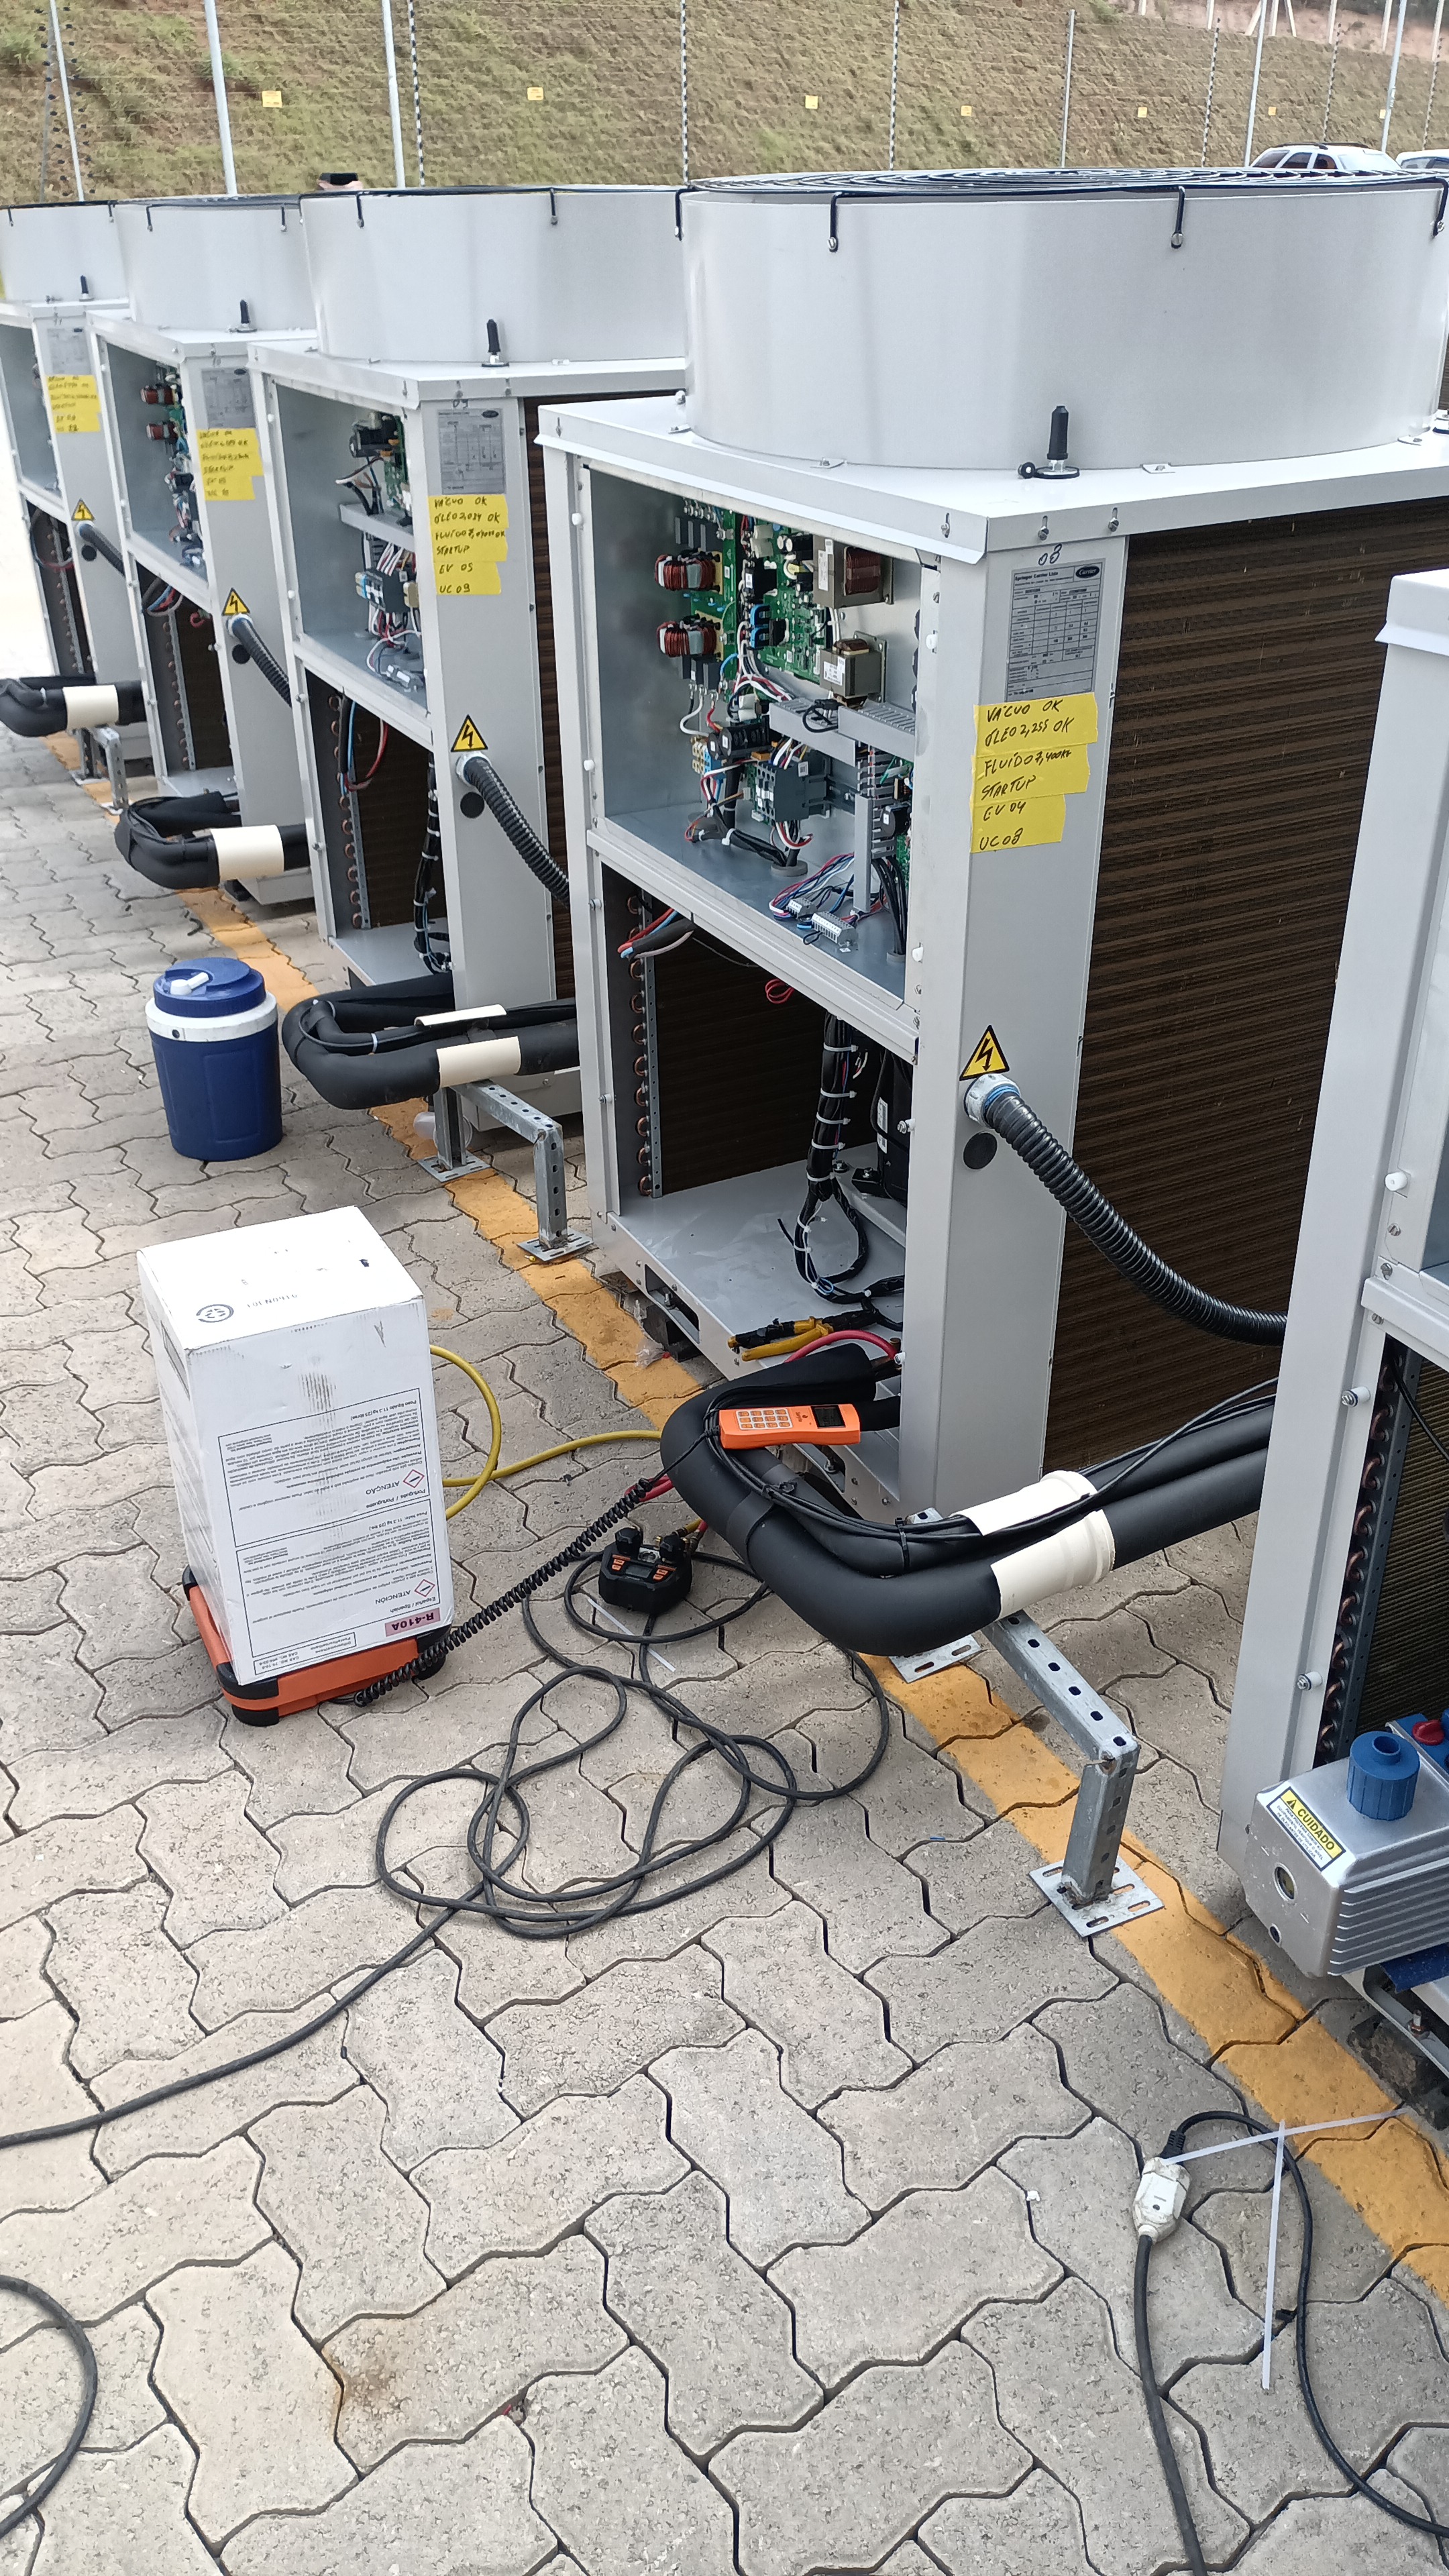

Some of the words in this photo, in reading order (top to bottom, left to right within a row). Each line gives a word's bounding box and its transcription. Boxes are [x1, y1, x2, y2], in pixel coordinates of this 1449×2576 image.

[475, 496, 487, 506] OK
[488, 512, 500, 523] OK
[1038, 543, 1062, 566] 08
[1042, 699, 1063, 712] OK
[1053, 717, 1075, 733] OK
[981, 775, 1036, 800] STARTUP
[365, 1480, 400, 1495] ATENÇÃO
[375, 1589, 411, 1605] ATENCIÓN
[415, 1596, 435, 1606] Español
[390, 1603, 411, 1613] Spanish
[391, 1612, 434, 1631] R-410A
[1298, 1809, 1334, 1849] CUIDADO
